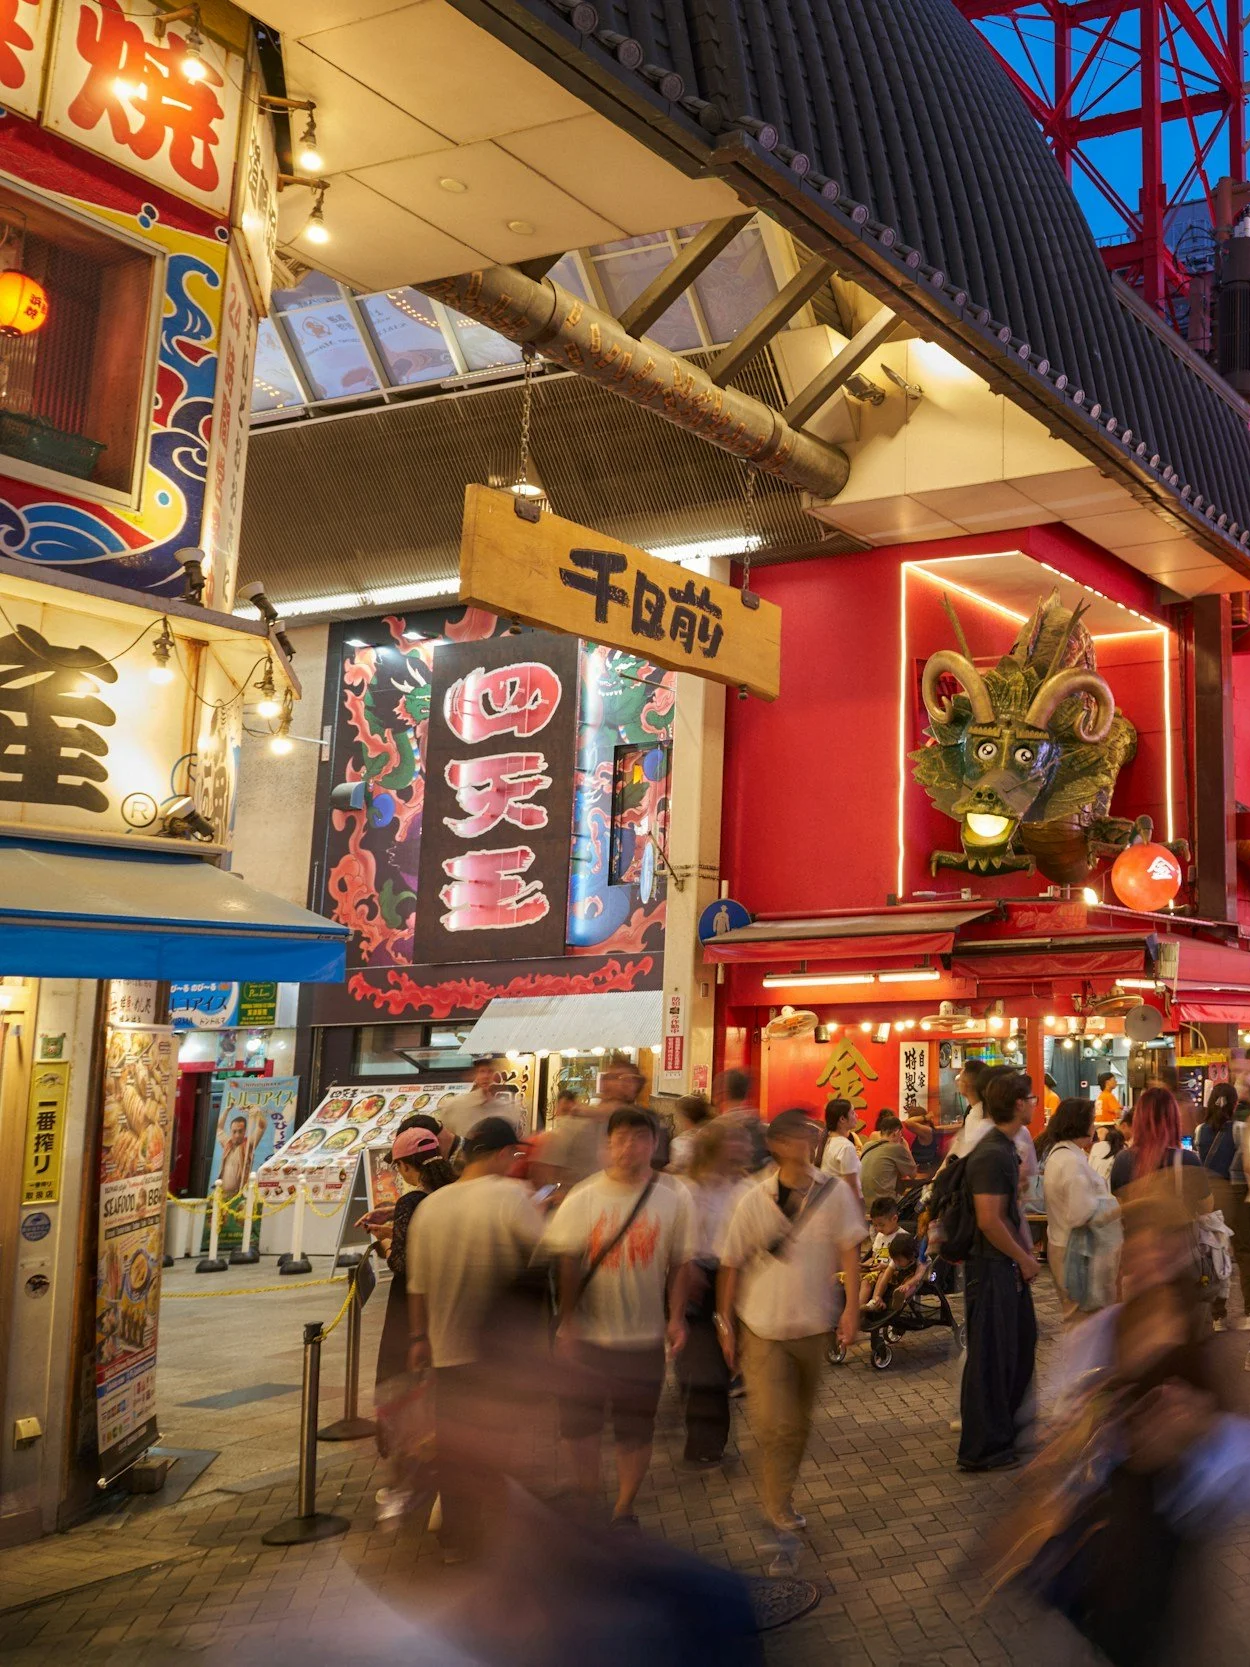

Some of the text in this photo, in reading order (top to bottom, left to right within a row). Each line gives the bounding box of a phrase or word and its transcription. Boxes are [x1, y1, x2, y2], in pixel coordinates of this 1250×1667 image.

[558, 547, 724, 659] 千日前
[439, 661, 562, 932] 四天王
[33, 1101, 58, 1174] 一番搾り
[226, 1090, 295, 1108] トルコアイス
